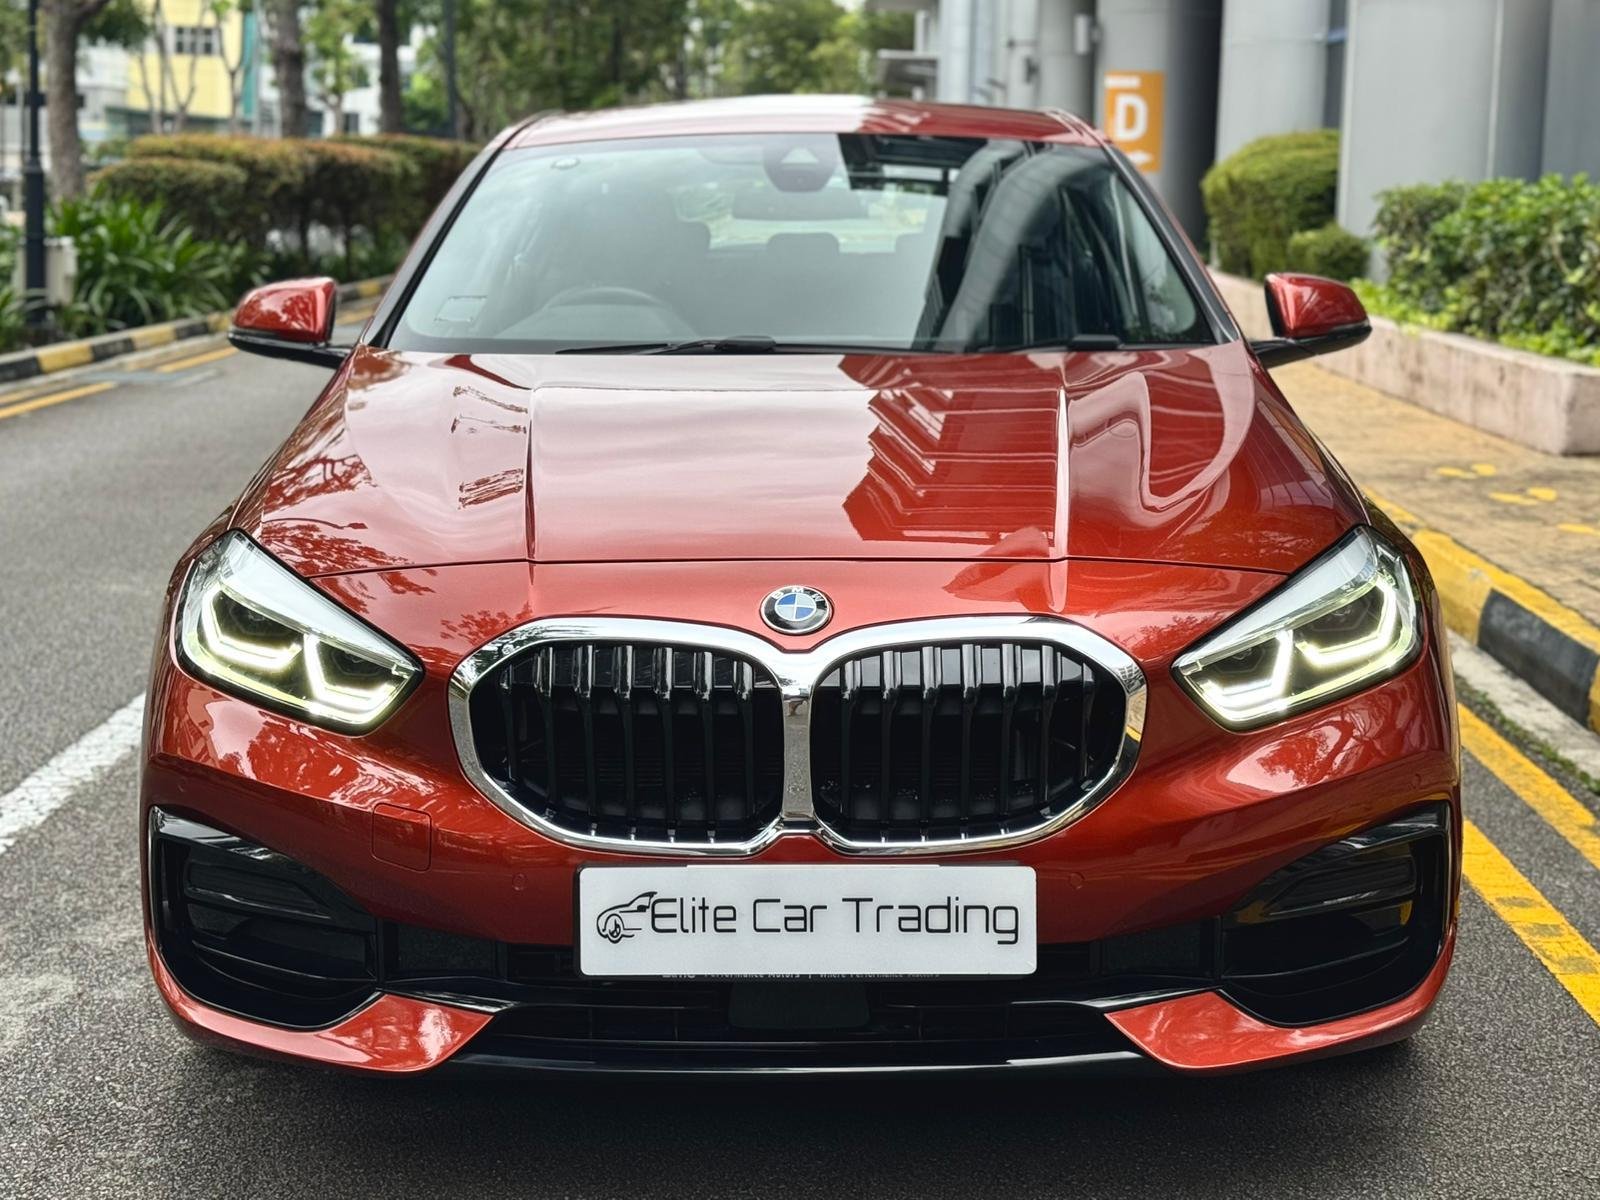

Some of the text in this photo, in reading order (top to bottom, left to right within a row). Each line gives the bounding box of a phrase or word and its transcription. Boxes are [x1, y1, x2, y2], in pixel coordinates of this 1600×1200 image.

[1115, 93, 1147, 140] D
[771, 587, 825, 602] BMW
[651, 896, 1019, 945] Elite Car Trading
